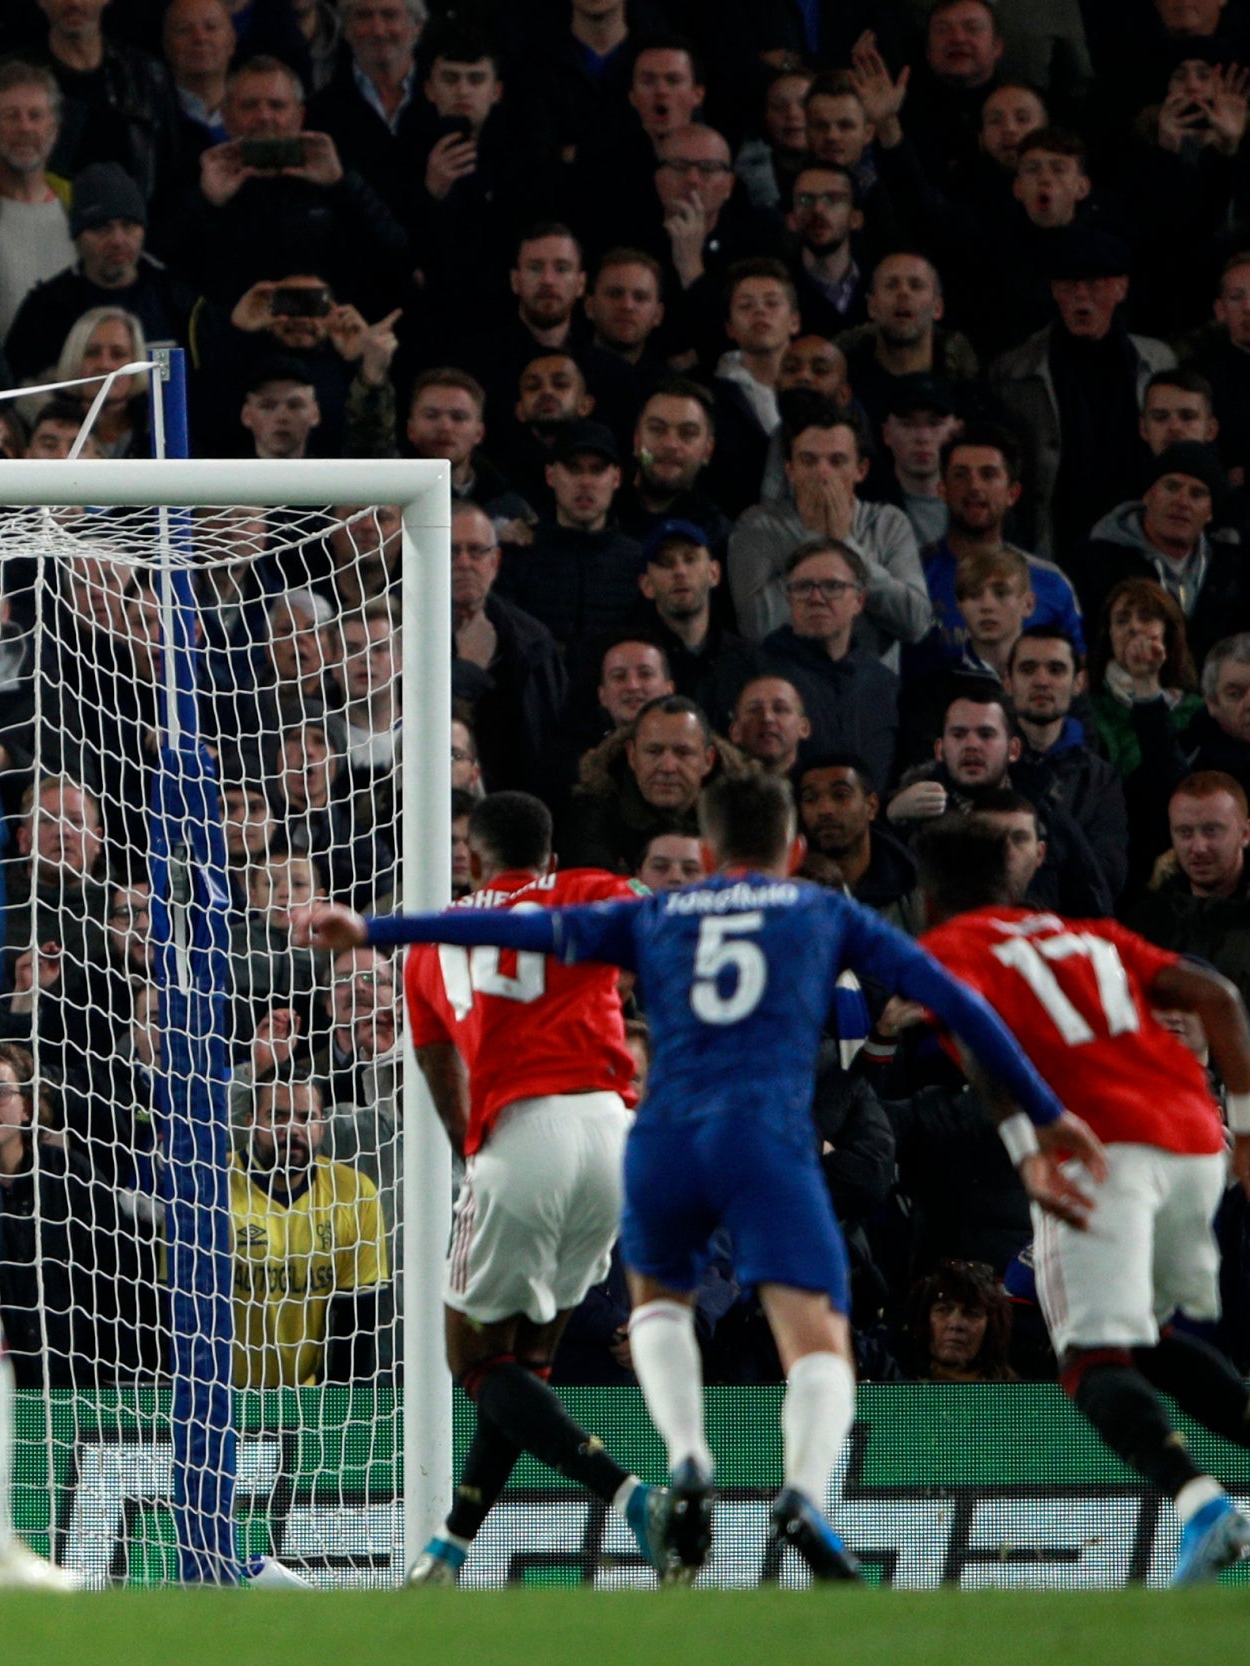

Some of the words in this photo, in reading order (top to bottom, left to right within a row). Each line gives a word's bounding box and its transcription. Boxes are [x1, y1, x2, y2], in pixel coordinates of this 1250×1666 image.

[690, 911, 768, 1026] 5
[990, 931, 1141, 1047] 17
[234, 1264, 335, 1293] AUTOGLASS
